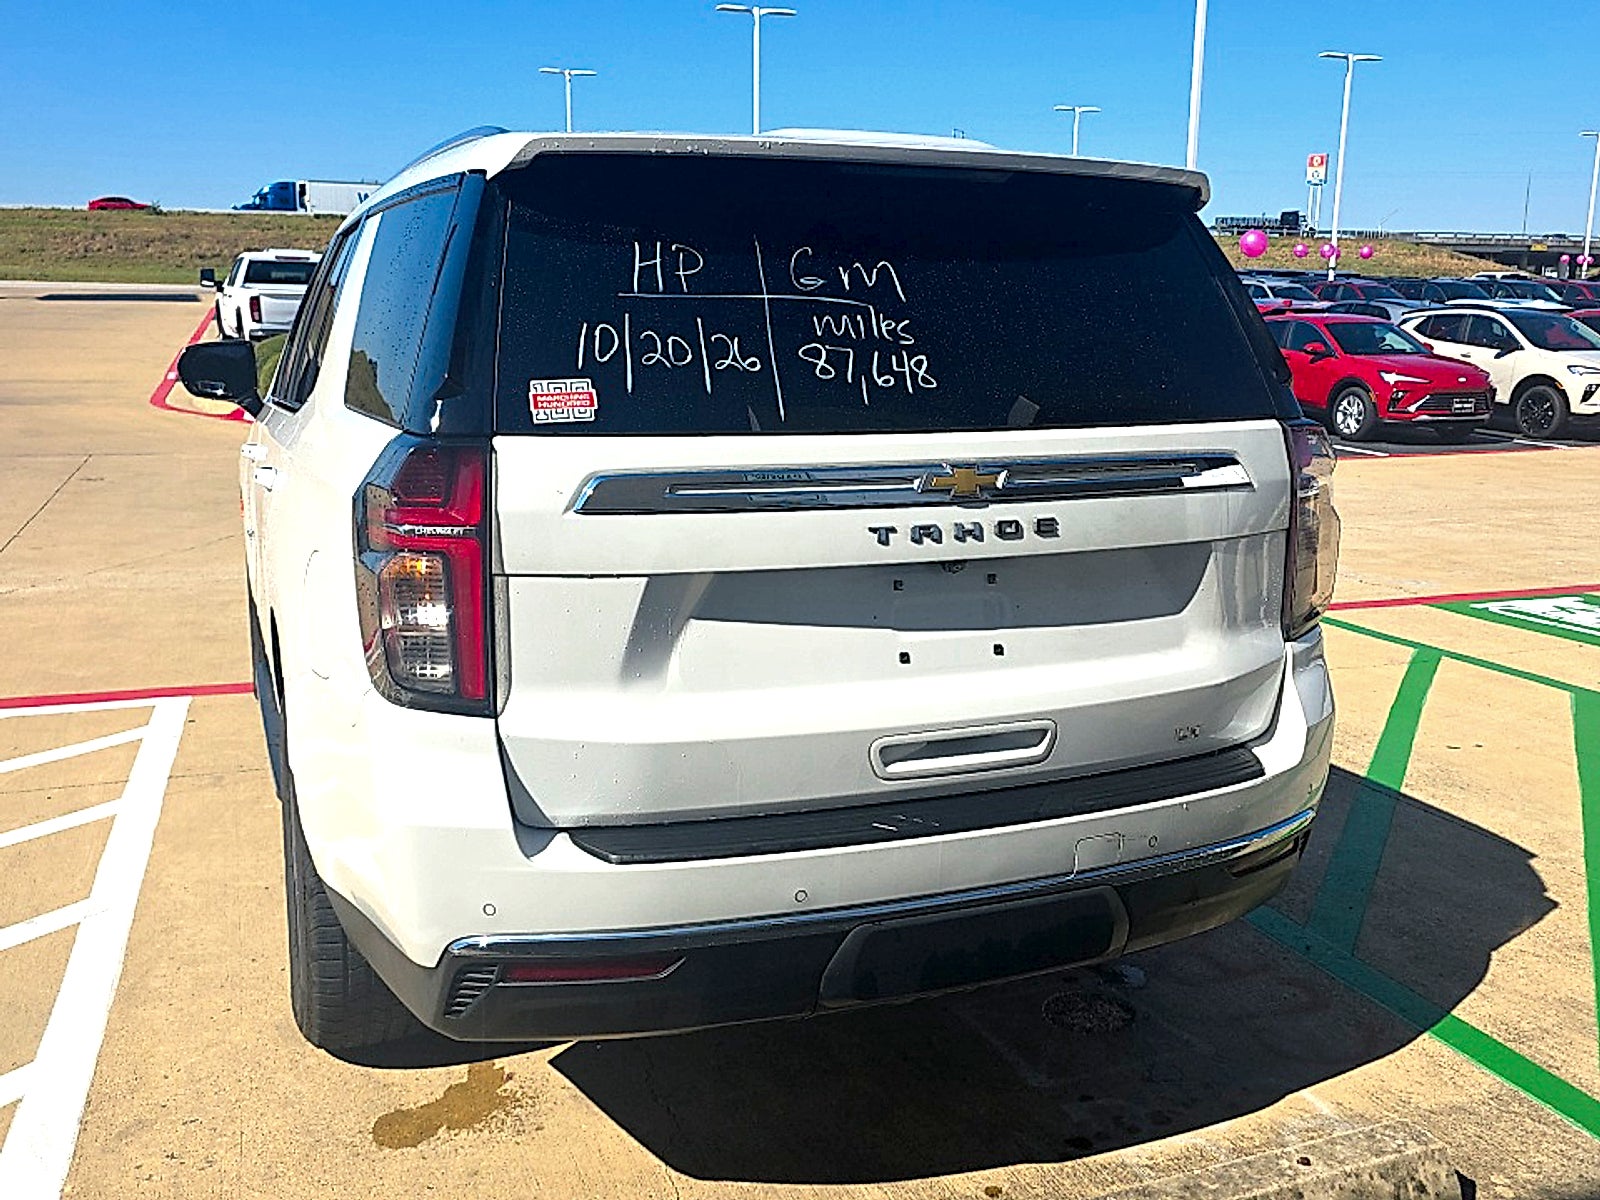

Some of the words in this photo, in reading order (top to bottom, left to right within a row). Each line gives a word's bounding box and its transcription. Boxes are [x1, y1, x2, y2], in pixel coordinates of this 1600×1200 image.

[633, 241, 703, 293] HP
[813, 306, 915, 345] miles
[798, 342, 938, 405] 87,648
[867, 516, 1061, 547] TAHOE
